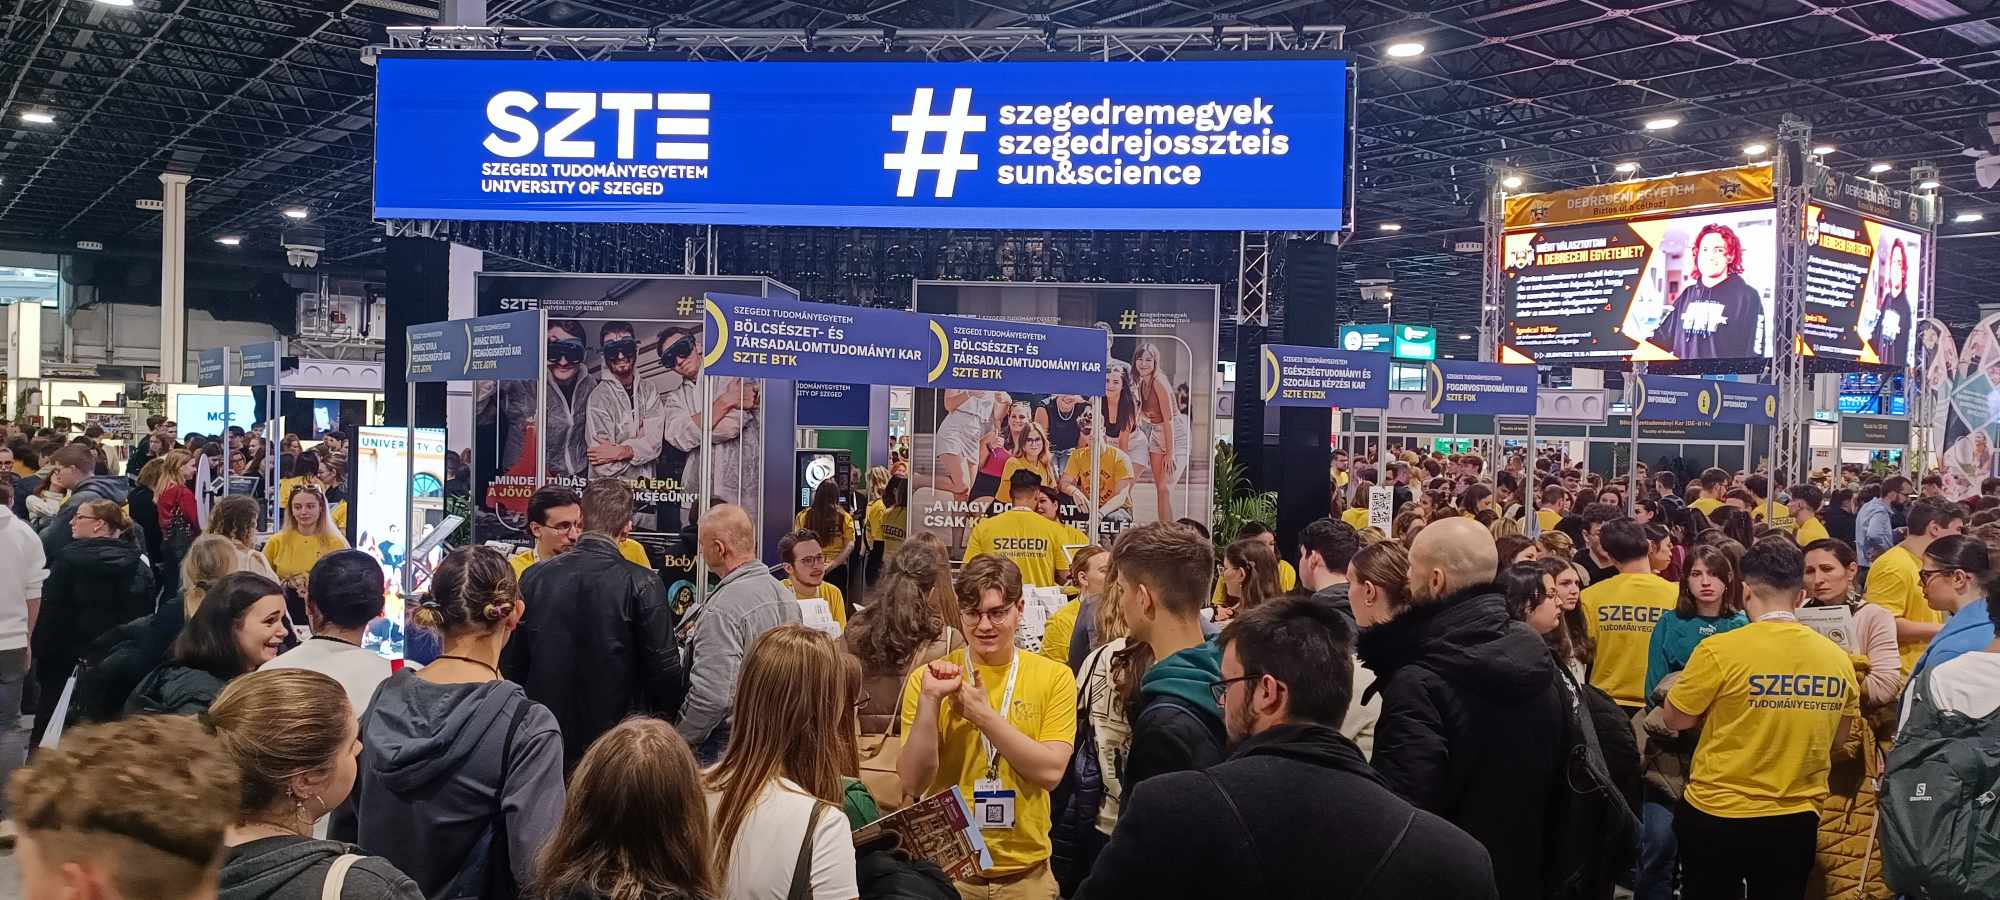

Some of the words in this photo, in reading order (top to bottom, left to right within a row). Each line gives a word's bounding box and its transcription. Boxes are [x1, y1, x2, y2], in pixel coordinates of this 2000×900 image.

[998, 97, 1274, 132] szegedremegyek
[482, 90, 711, 160] SZTE
[998, 128, 1289, 162] szegedrejosszteis
[481, 162, 548, 177] SZEGEDI
[552, 161, 708, 179] TUDOMÁNYEGYETEM
[997, 159, 1202, 186] sun&science
[481, 179, 574, 194] UNIVERSITY
[578, 181, 600, 194] OF
[603, 182, 664, 195] SZEGED
[1545, 250, 1589, 265] DEBRECENI
[500, 298, 538, 310] SZTE
[733, 306, 771, 317] SZEGEDI
[772, 308, 854, 324] TUDOMÁNYEGYETEM
[734, 319, 825, 338] BÖLCSÉSZET-
[828, 325, 844, 340] ÉS
[953, 326, 982, 336] SZEGEDI
[983, 328, 1047, 341] TUDOMÁNYEGYETEM
[733, 335, 896, 359] TÁRSADALOMTUDOMÁNYI
[898, 348, 922, 361] KAR
[953, 337, 1024, 354] BÖLCSÉSZET-
[1026, 342, 1039, 355] ÉS
[732, 351, 768, 364] SZTE
[771, 354, 798, 367] BTK
[953, 351, 1080, 371] TÁRSADALOMTUDOMÁNYI
[1081, 361, 1101, 372] KAR
[952, 367, 980, 378] SZTE
[981, 368, 1002, 380] BTK
[1283, 364, 1361, 379] EGÉSZSÉGTUDOMÁNYI
[1362, 368, 1372, 379] ÉS
[1282, 377, 1320, 388] SZOCIÁLIS
[1321, 378, 1351, 389] KÉPZÉSI
[1351, 381, 1366, 390] KAR
[1515, 385, 1528, 394] KAR
[1282, 389, 1303, 399] SZTE
[1446, 393, 1463, 401] SZTE
[1463, 393, 1477, 401] FOK
[362, 437, 428, 452] UNIVERTY
[487, 487, 497, 497] A
[947, 500, 989, 513] NAGY
[924, 516, 965, 528] CSAK
[993, 537, 1048, 551] SZEGEDI
[1598, 605, 1661, 623] SZEGE
[1599, 623, 1655, 633] TUDOMÁNYEG
[1748, 674, 1847, 699] SZEGEDI
[1749, 698, 1844, 711] TUDOMÁNYEGYETEM
